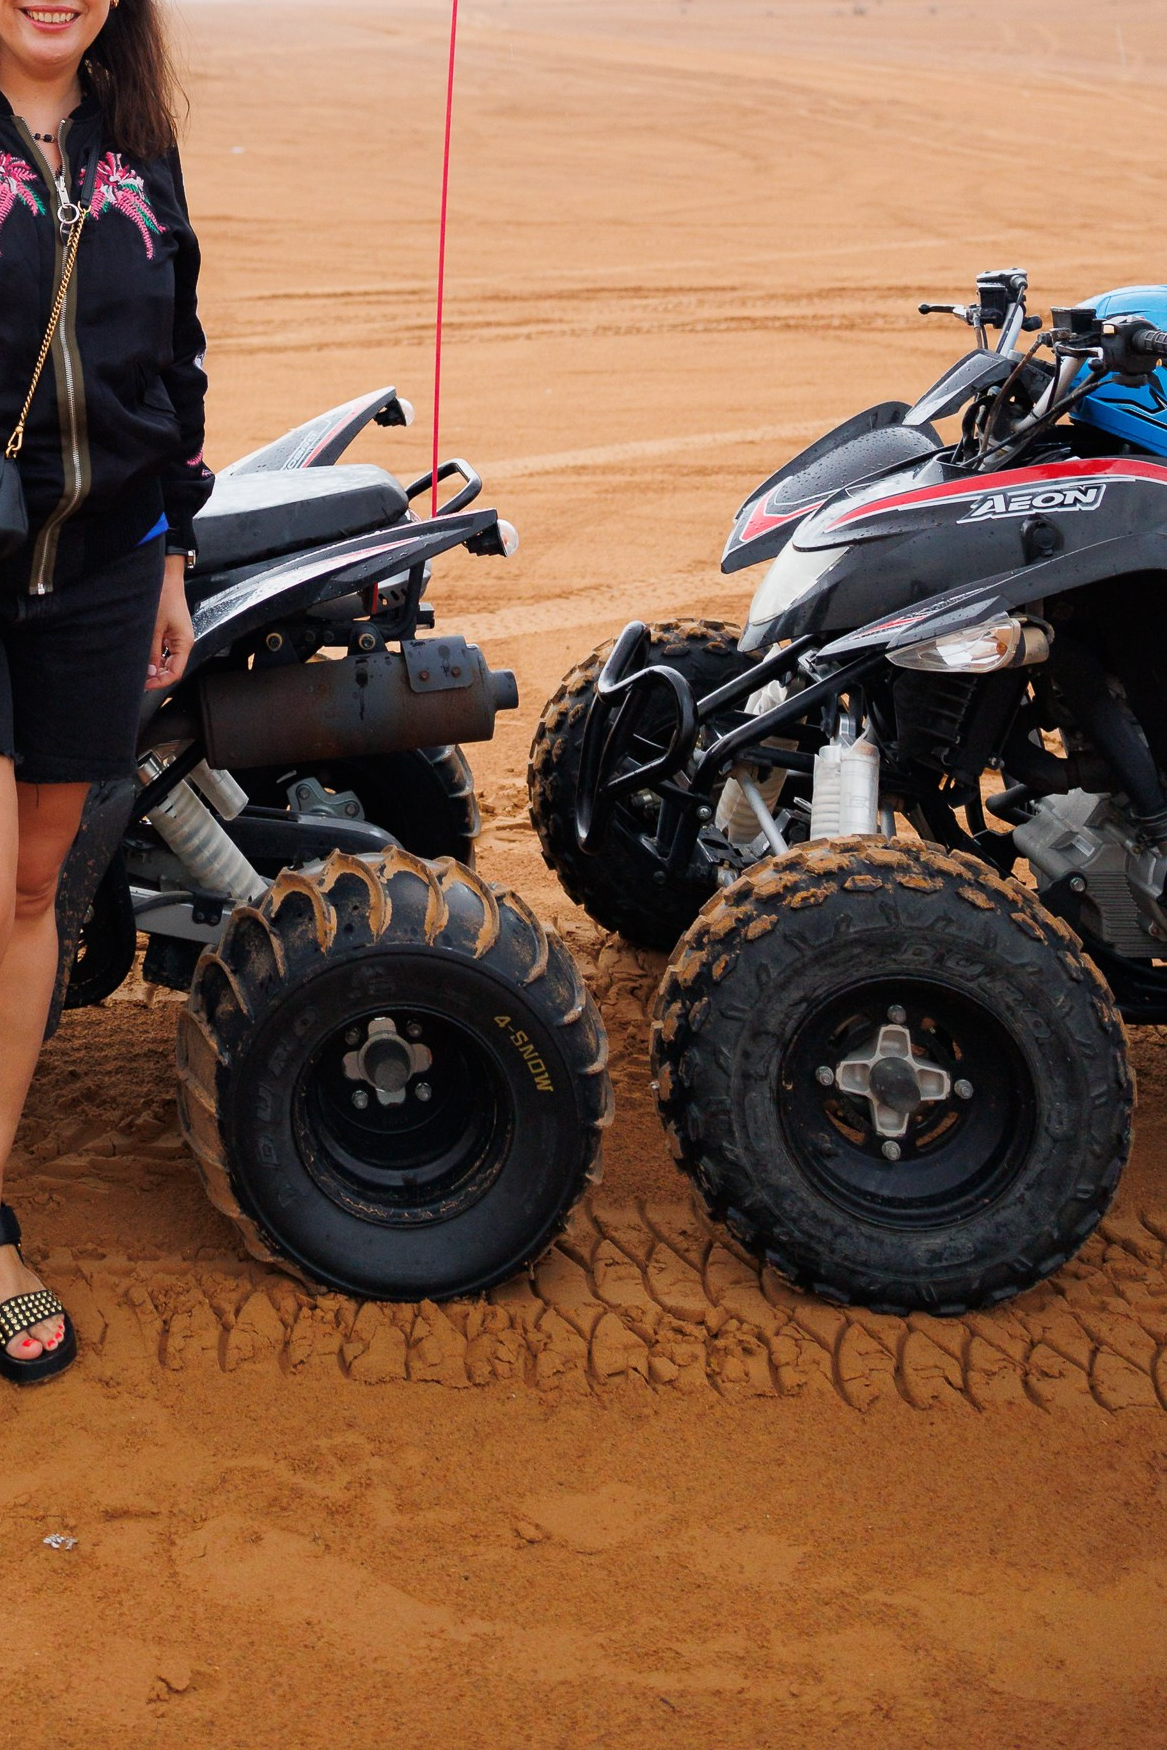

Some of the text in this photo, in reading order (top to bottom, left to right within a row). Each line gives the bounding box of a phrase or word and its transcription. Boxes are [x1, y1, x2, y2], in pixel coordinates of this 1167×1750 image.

[968, 487, 1098, 518] AEON
[896, 940, 1054, 1041] DURO
[494, 1016, 554, 1092] 4-SNOW
